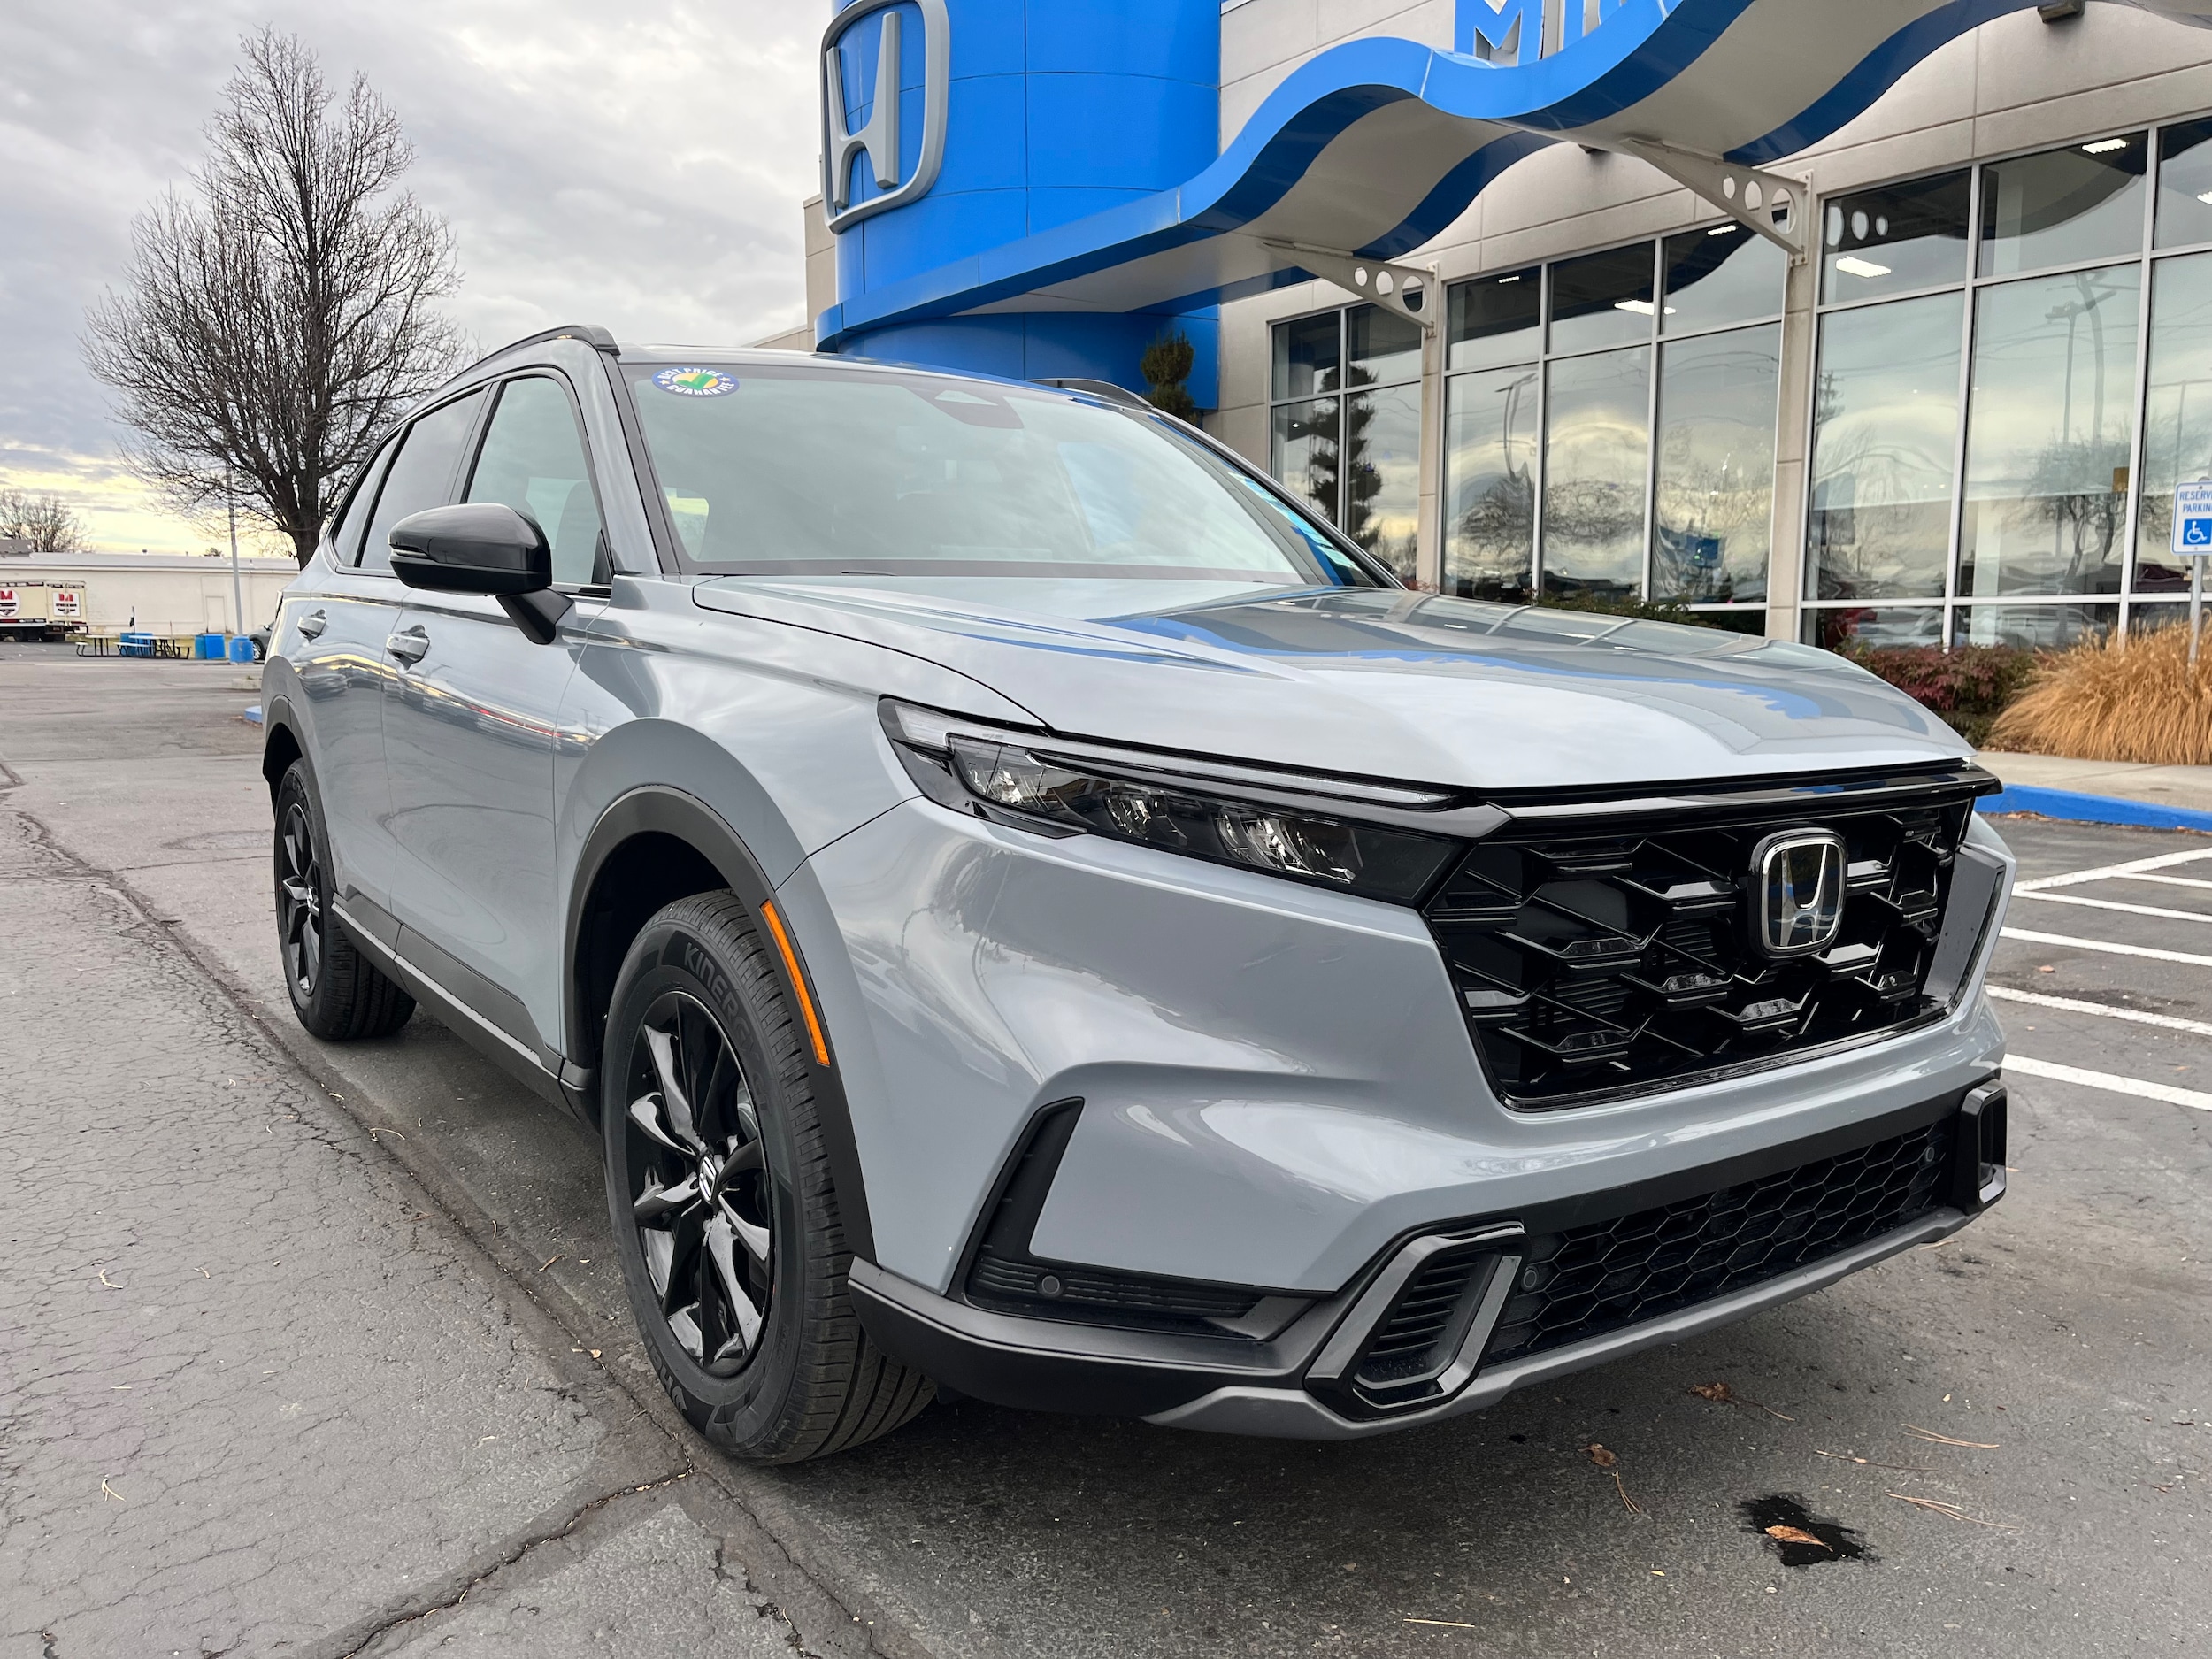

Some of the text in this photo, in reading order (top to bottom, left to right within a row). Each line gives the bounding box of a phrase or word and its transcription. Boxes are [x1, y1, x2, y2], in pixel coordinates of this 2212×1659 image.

[657, 367, 725, 380] BEST PRICE
[665, 381, 735, 396] GUARANTEE
[2178, 489, 2212, 501] RESERV
[2182, 503, 2212, 513] PARKIN
